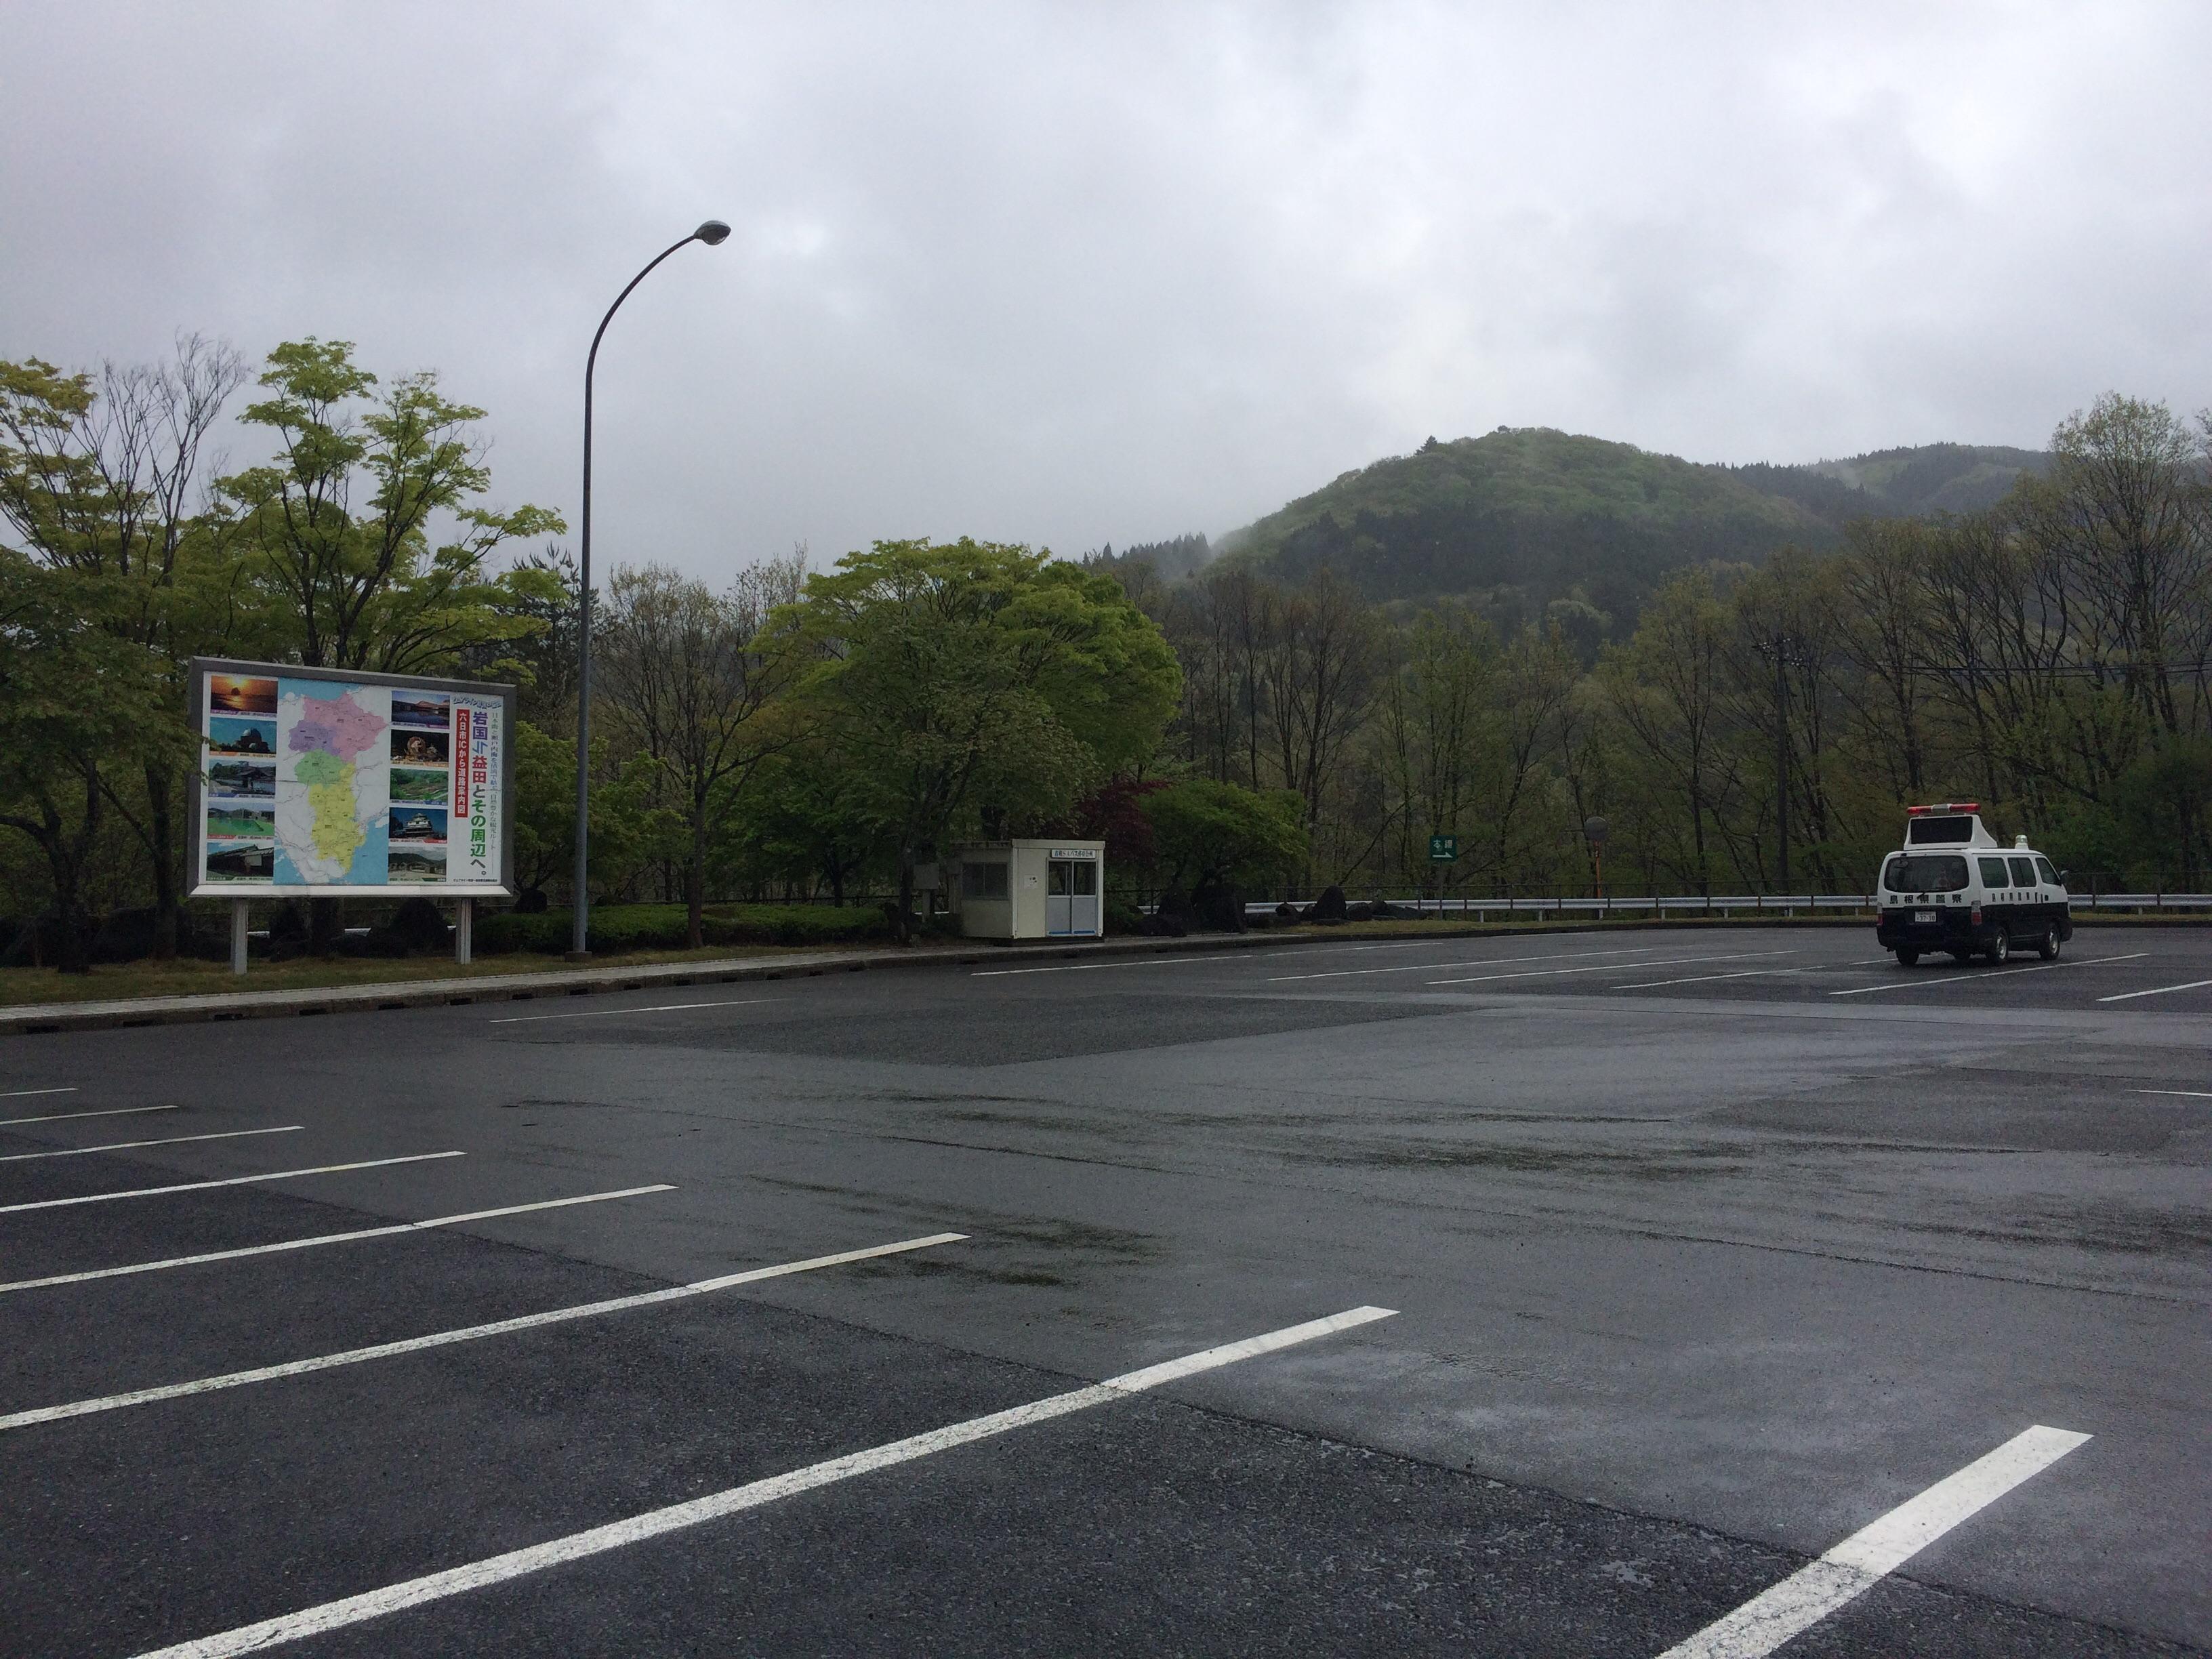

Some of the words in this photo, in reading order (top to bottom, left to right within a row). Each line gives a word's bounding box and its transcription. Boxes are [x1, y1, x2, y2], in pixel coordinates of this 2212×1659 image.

[472, 711, 489, 740] 岩国
[457, 712, 468, 815] 六日市ICから道路案内図
[1889, 894, 1962, 904] 島根県警察
